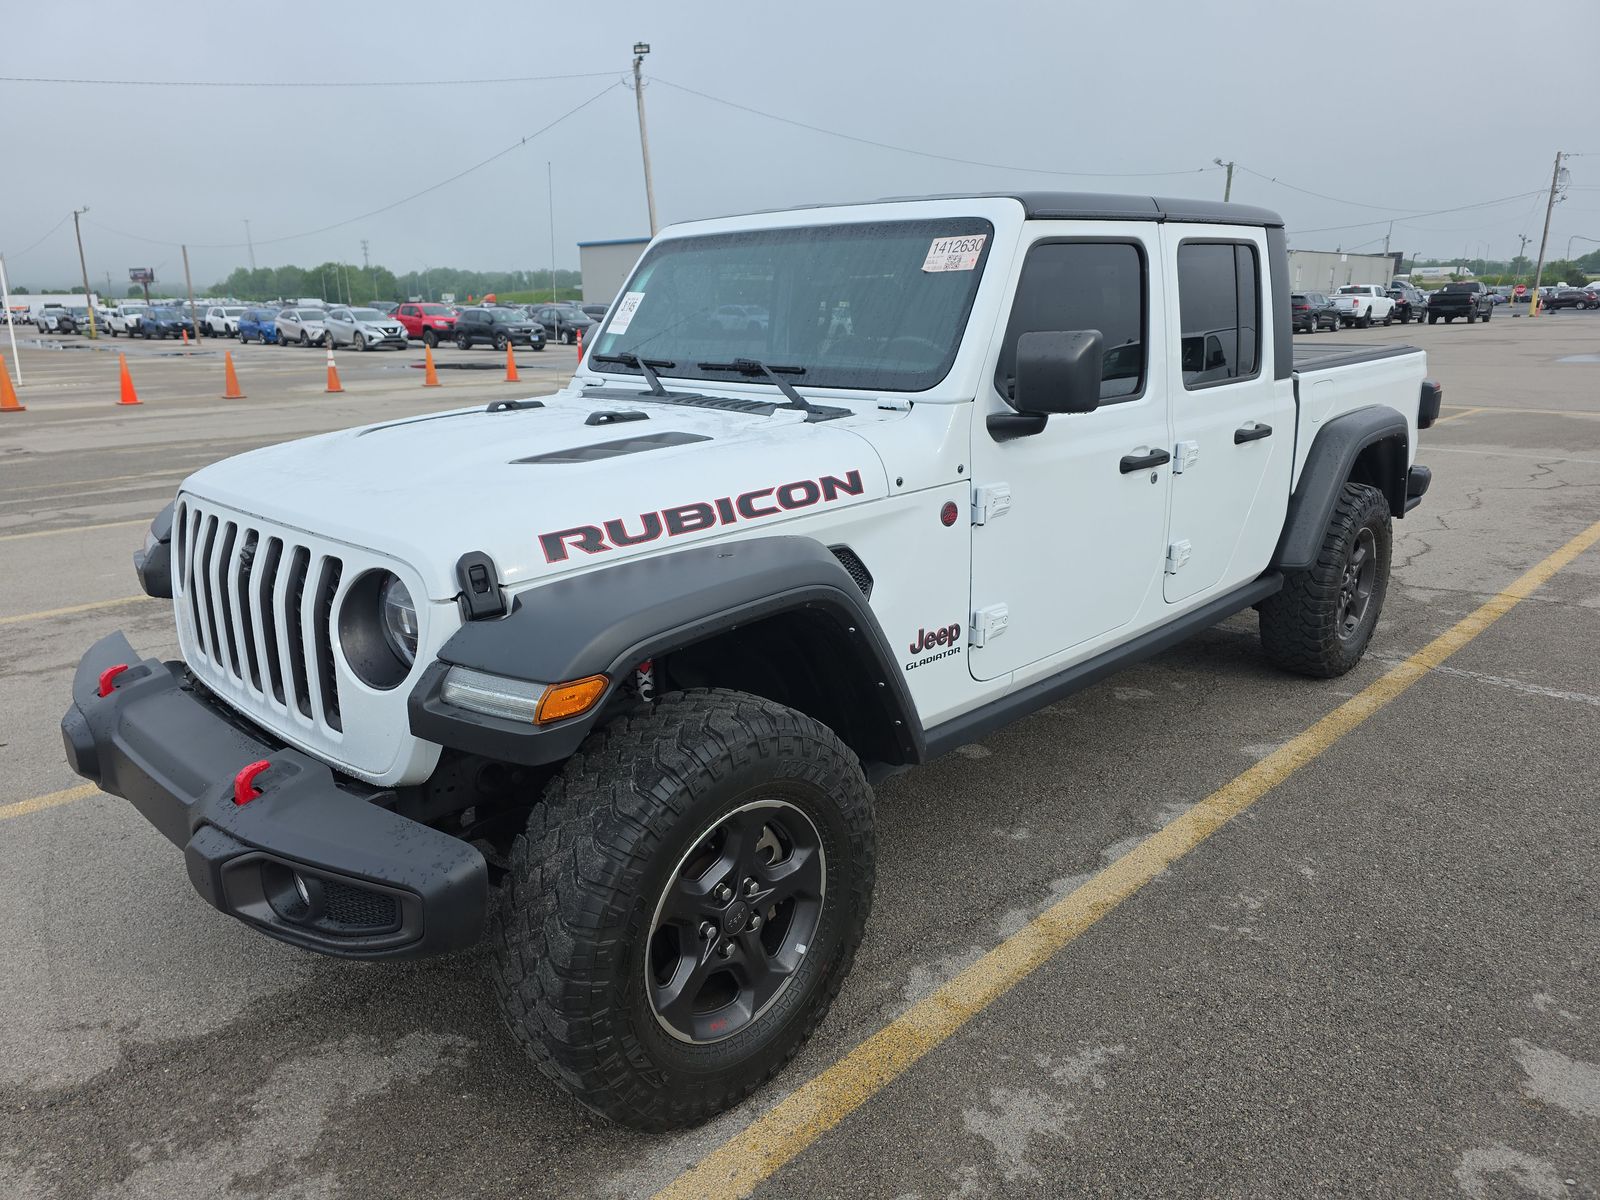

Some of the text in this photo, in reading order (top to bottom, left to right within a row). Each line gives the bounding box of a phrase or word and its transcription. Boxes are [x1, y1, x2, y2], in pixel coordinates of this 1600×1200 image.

[933, 238, 985, 255] 1412630
[538, 469, 864, 564] RUBICON
[909, 623, 961, 654] Jeep
[905, 646, 961, 671] GLADIATOR
